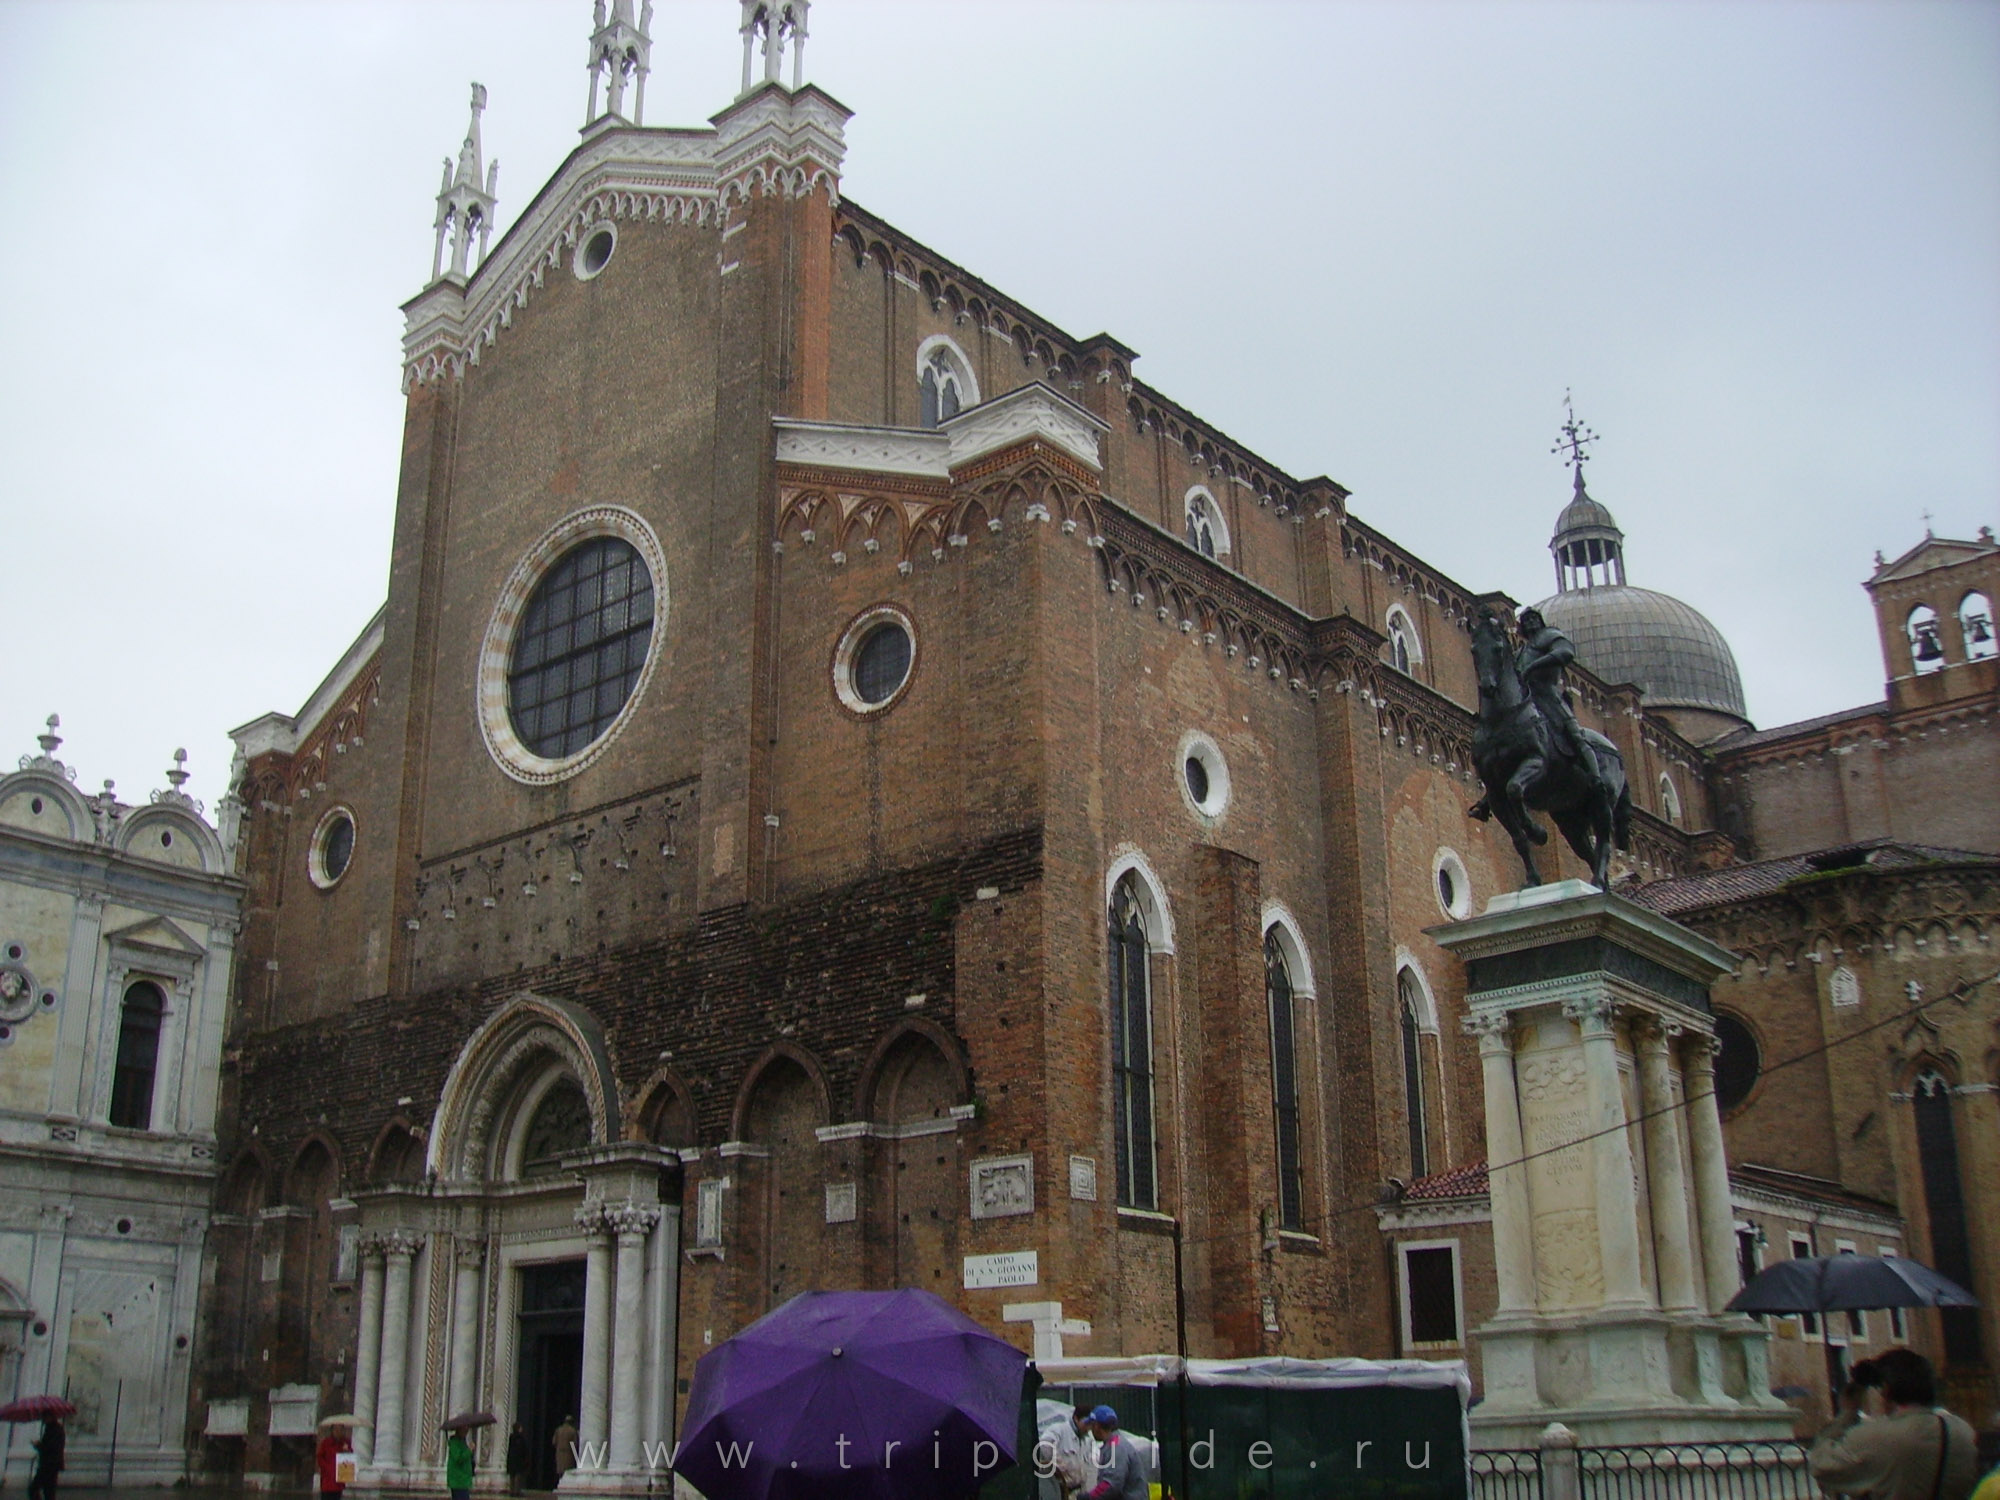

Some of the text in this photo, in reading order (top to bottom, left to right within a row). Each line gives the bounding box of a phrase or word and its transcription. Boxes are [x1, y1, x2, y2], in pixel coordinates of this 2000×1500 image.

[986, 1256, 1015, 1265] CAMPO
[965, 1268, 974, 1277] DI
[997, 1263, 1035, 1274] GIOVANNI
[998, 1274, 1025, 1284] PAOLO
